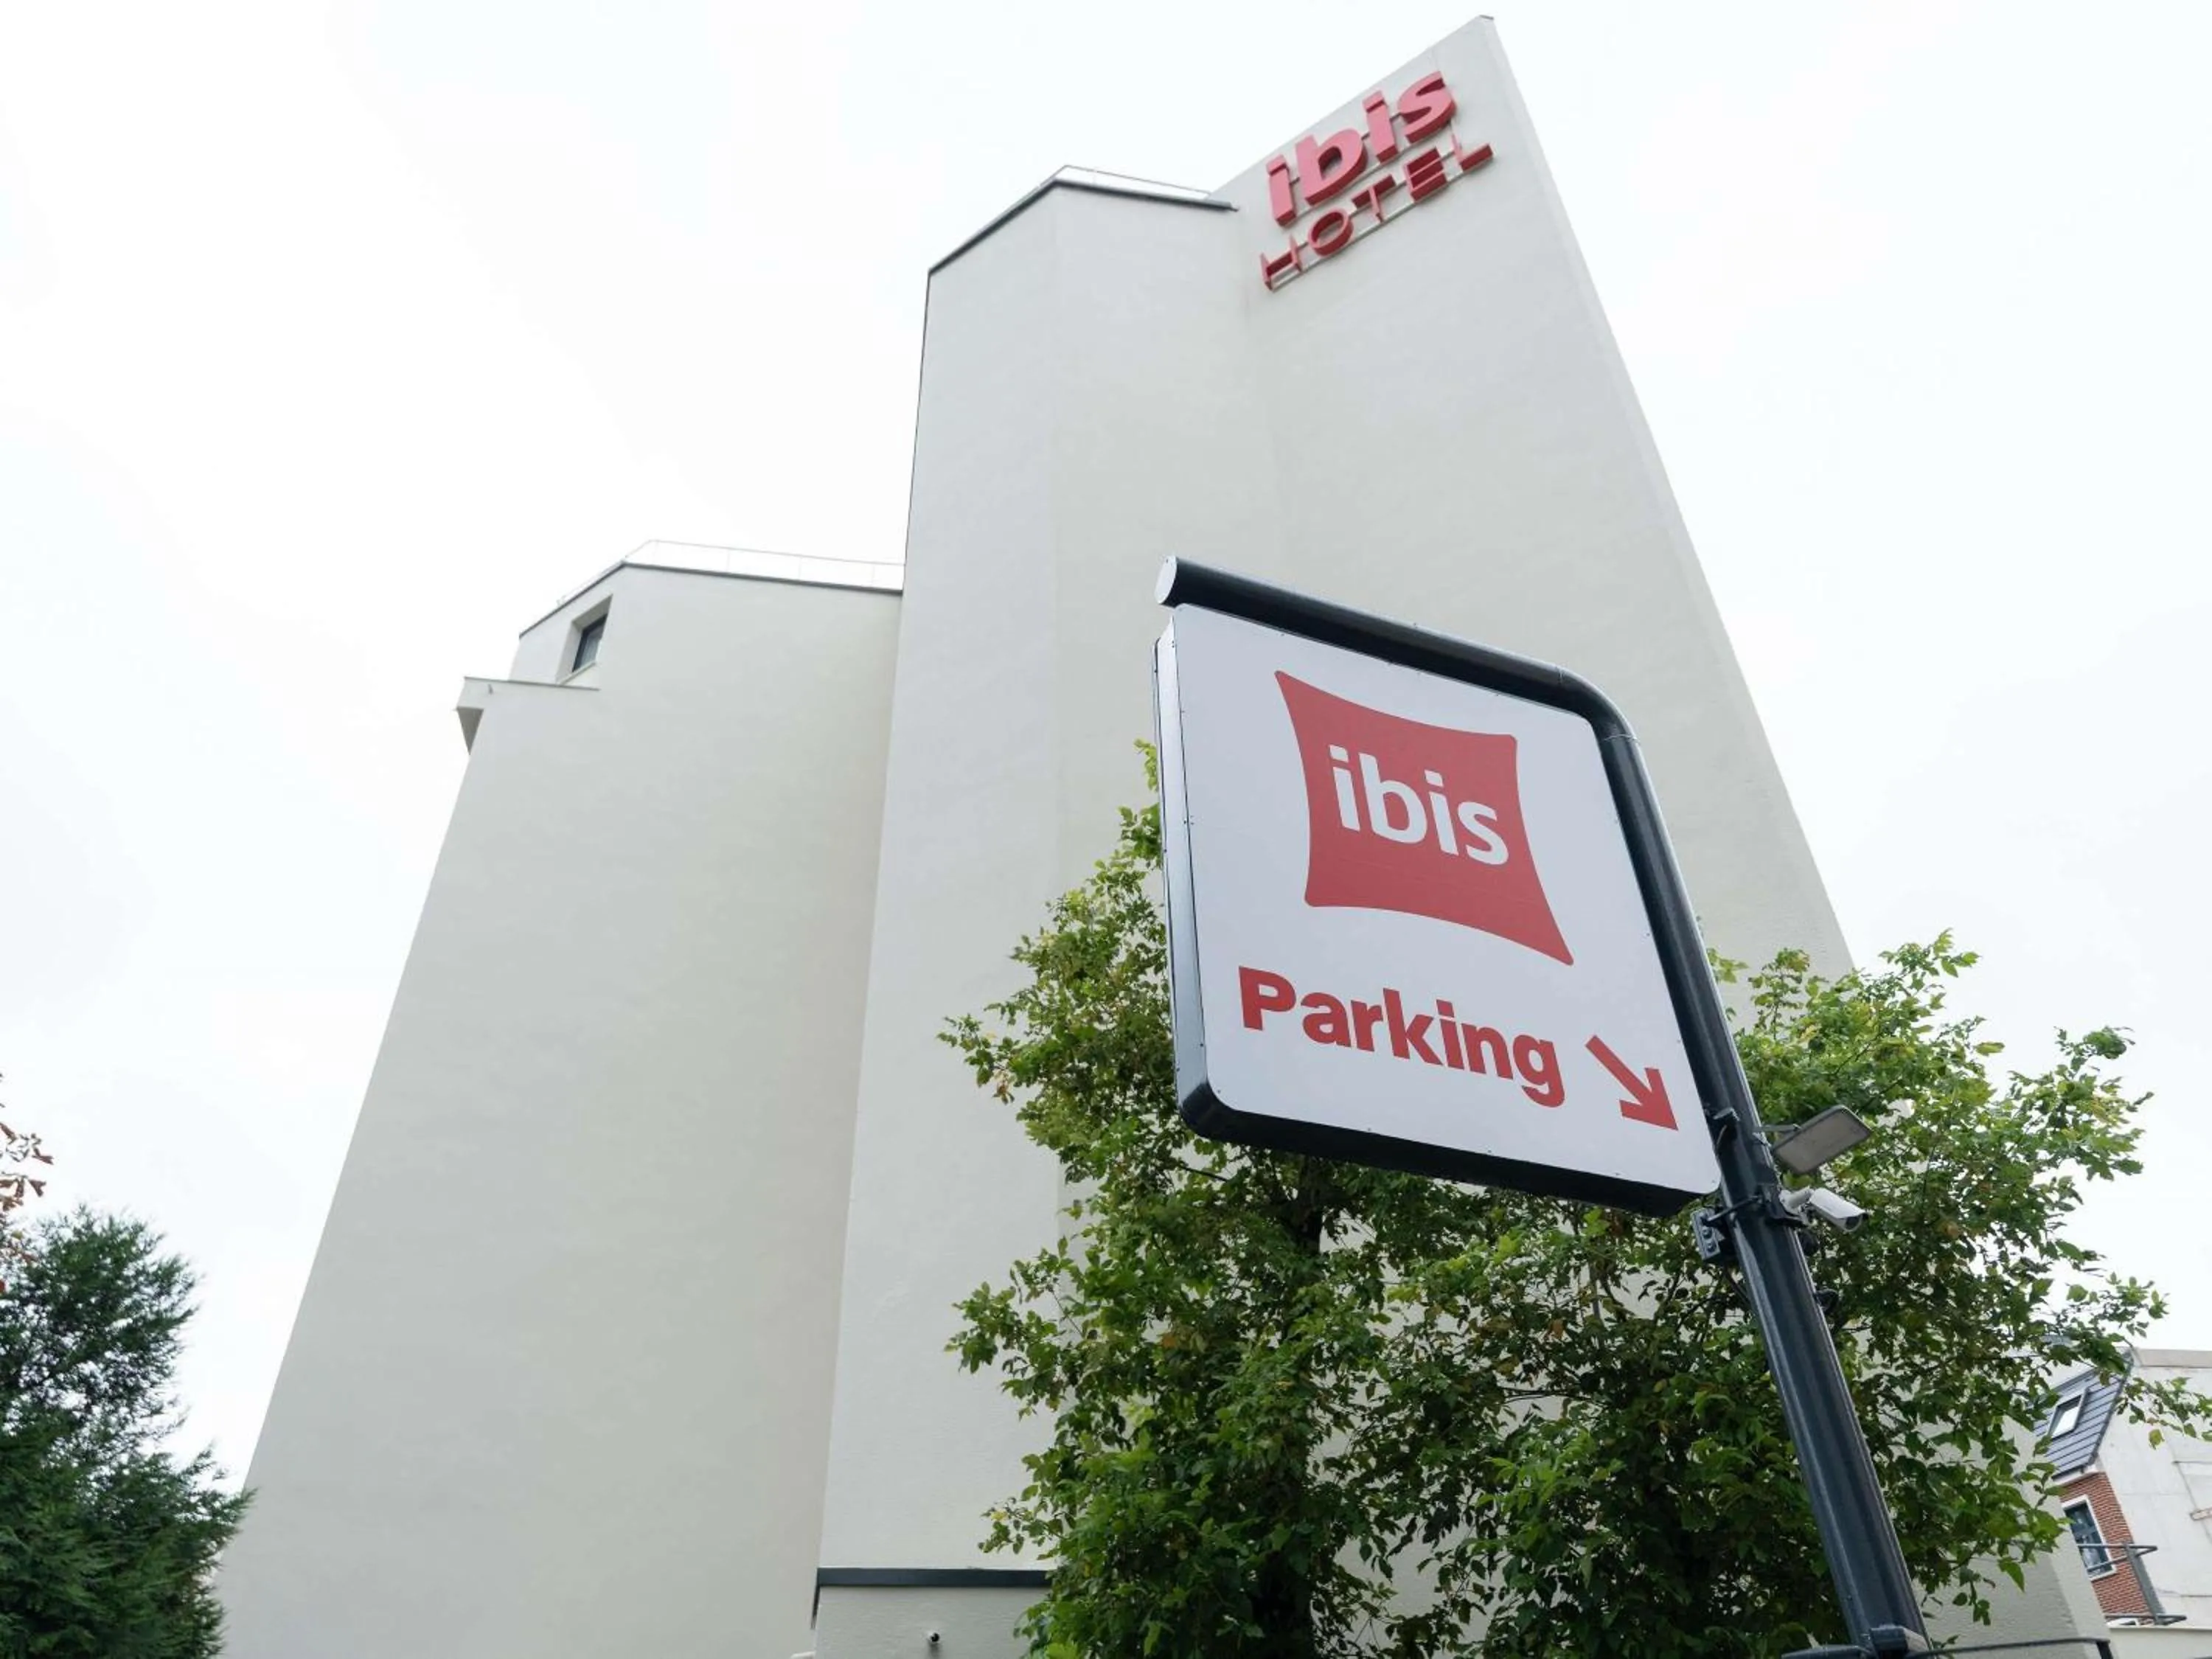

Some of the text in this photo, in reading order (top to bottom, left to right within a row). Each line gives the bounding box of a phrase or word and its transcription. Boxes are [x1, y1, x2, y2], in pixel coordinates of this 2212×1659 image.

[1259, 127, 1494, 291] HOTEL
[1265, 70, 1457, 227] ibis
[1329, 744, 1510, 866] ibis
[1238, 967, 1566, 1107] Parking
